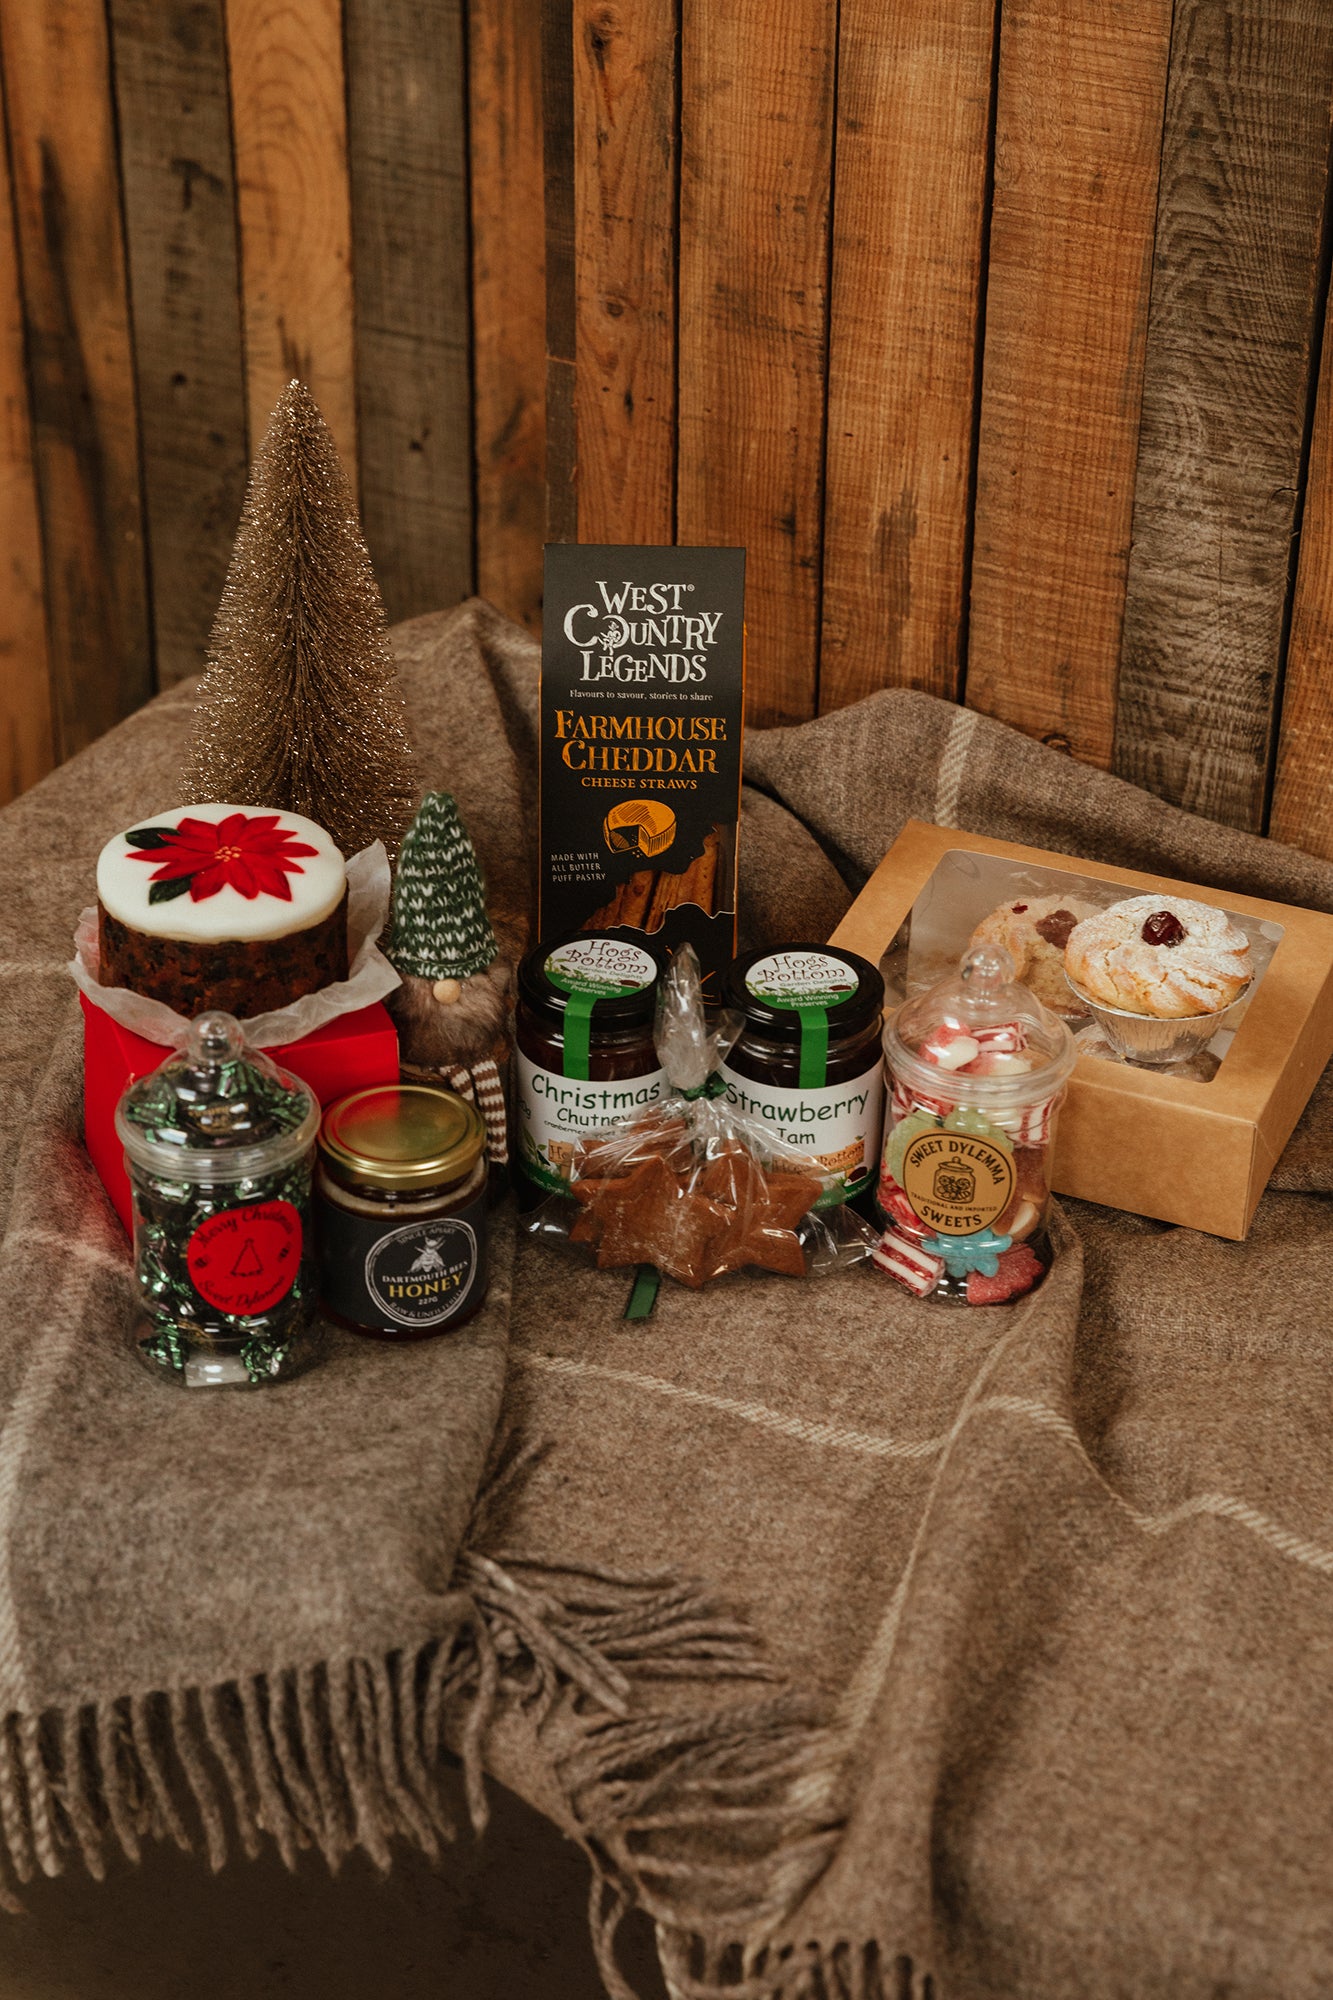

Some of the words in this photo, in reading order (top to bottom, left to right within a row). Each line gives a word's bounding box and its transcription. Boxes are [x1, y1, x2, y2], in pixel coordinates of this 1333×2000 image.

[563, 604, 723, 651] COUNTRY
[579, 651, 707, 683] LEGENDS
[570, 689, 604, 698] Flavours
[606, 690, 615, 698] to
[617, 691, 647, 700] savour,
[649, 691, 677, 700] stories
[680, 692, 688, 700] to
[690, 692, 713, 701] share
[554, 709, 727, 741] FARMHOUSE
[562, 740, 719, 774] CHEDDAR
[581, 777, 636, 788] CHEESE
[640, 778, 698, 790] STRAWS
[551, 853, 575, 861] MADE
[577, 852, 599, 860] WITH
[569, 863, 601, 871] BUTTER
[552, 874, 572, 882] PUFF
[576, 873, 606, 881] PASTRY
[583, 941, 641, 962] Hogs
[566, 949, 648, 974] Bottom
[772, 955, 829, 972] Hogs
[757, 968, 846, 982] Bottom
[560, 978, 588, 987] Award
[588, 981, 622, 993] Winning
[570, 985, 607, 996] Preserves
[776, 995, 803, 1003] Award
[804, 993, 839, 1001] Winning
[791, 1000, 829, 1008] Preserves
[532, 1073, 661, 1110] Christmas
[725, 1082, 870, 1123] Strawberry
[909, 1139, 945, 1168] SWEET
[948, 1140, 1006, 1185] DYLEMMA
[911, 1191, 949, 1209] TRADITIONAL
[920, 1205, 983, 1228] SWEETS
[196, 1217, 239, 1248] Merry
[382, 1268, 448, 1283] DARTMOUTH
[449, 1261, 468, 1274] BEES
[389, 1271, 463, 1298] HONEY
[389, 1302, 409, 1315] RAW
[418, 1296, 439, 1305] 227G
